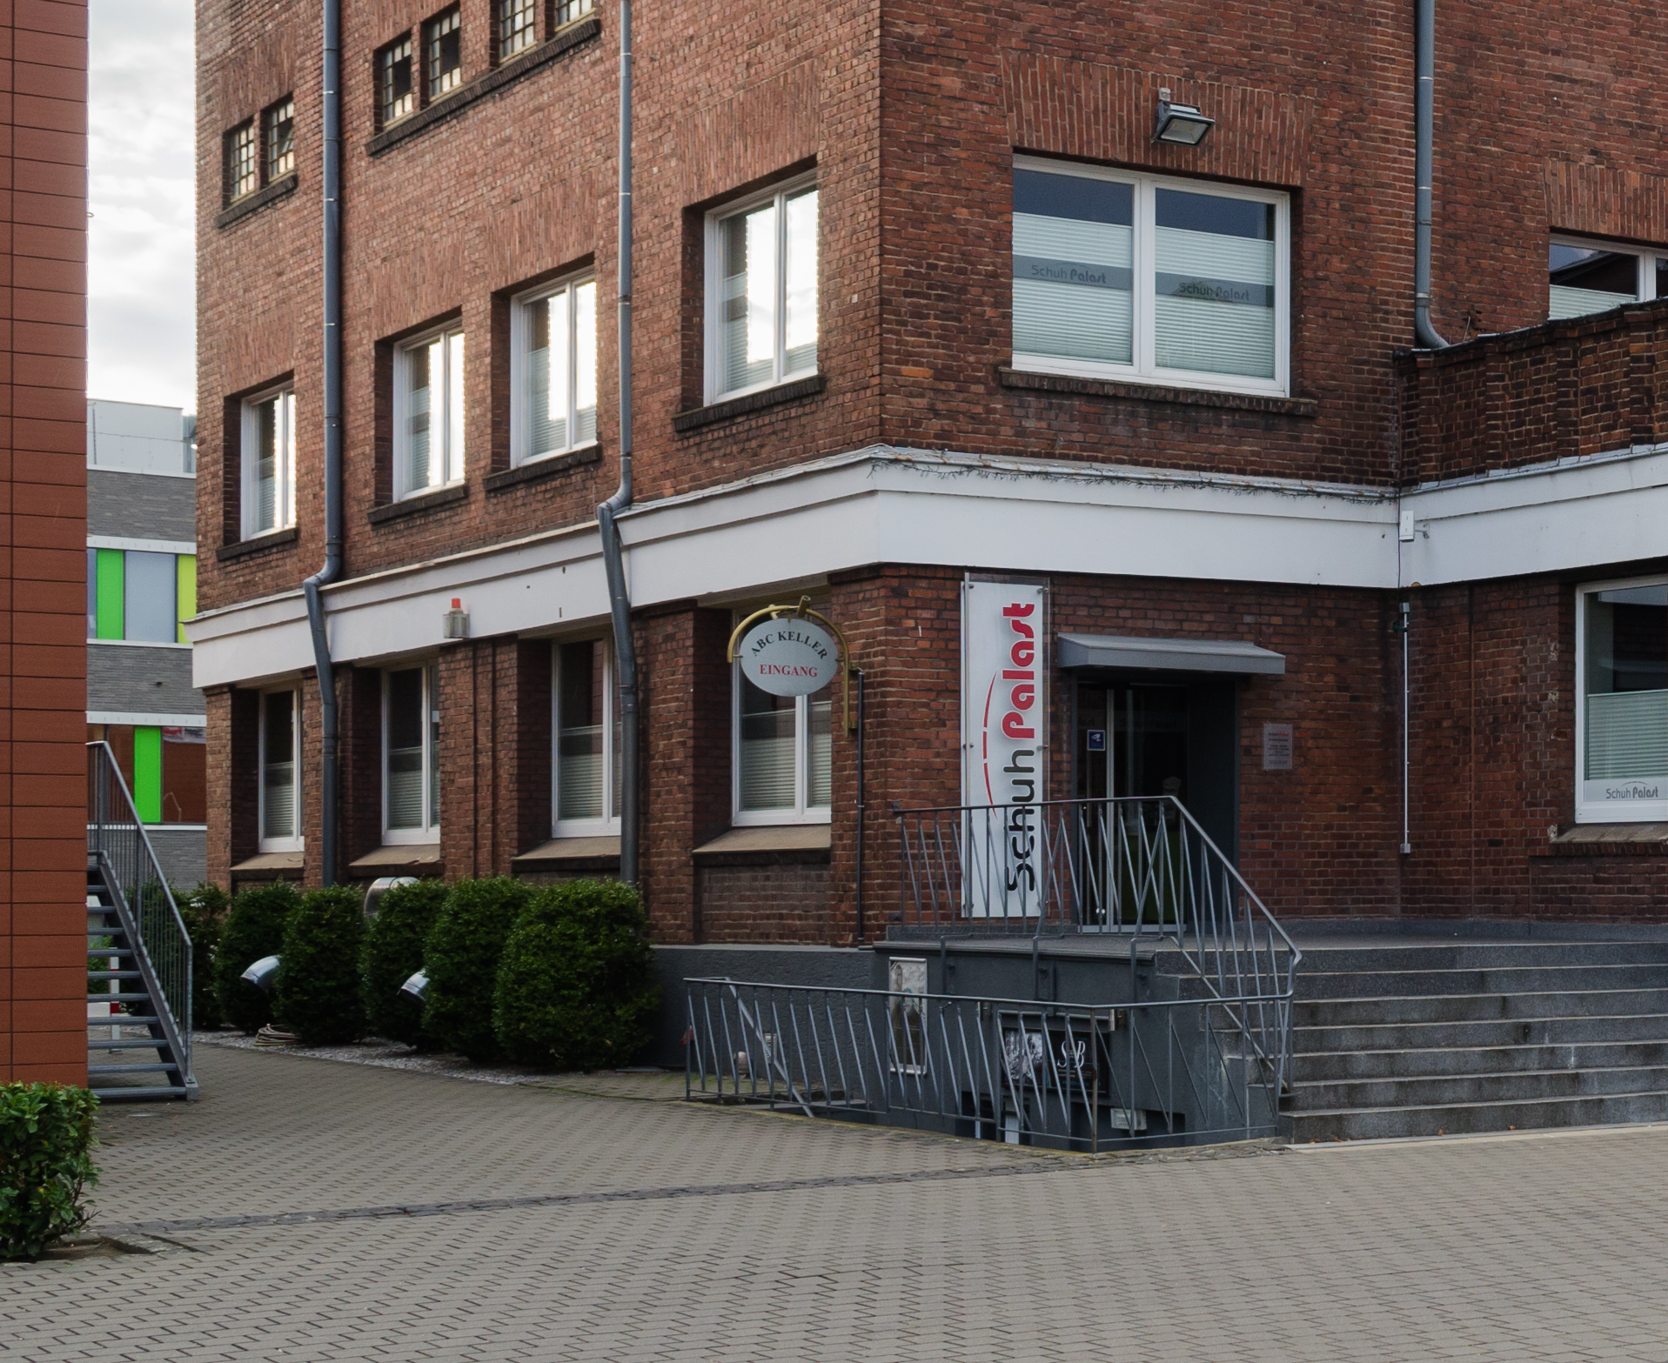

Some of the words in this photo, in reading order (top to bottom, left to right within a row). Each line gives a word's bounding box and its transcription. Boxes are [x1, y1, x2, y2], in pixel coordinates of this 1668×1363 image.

[1031, 264, 1068, 281] Schuh
[1070, 267, 1106, 284] Palast
[1179, 282, 1213, 297] Schuh
[1215, 285, 1250, 301] Palast
[751, 633, 775, 657] ABC
[777, 630, 828, 659] KELLER
[760, 664, 817, 677] EINGANG
[1001, 603, 1035, 739] Palast
[1606, 788, 1631, 799] Schuh
[1632, 786, 1658, 798] Palast
[1003, 749, 1035, 892] Schuh
